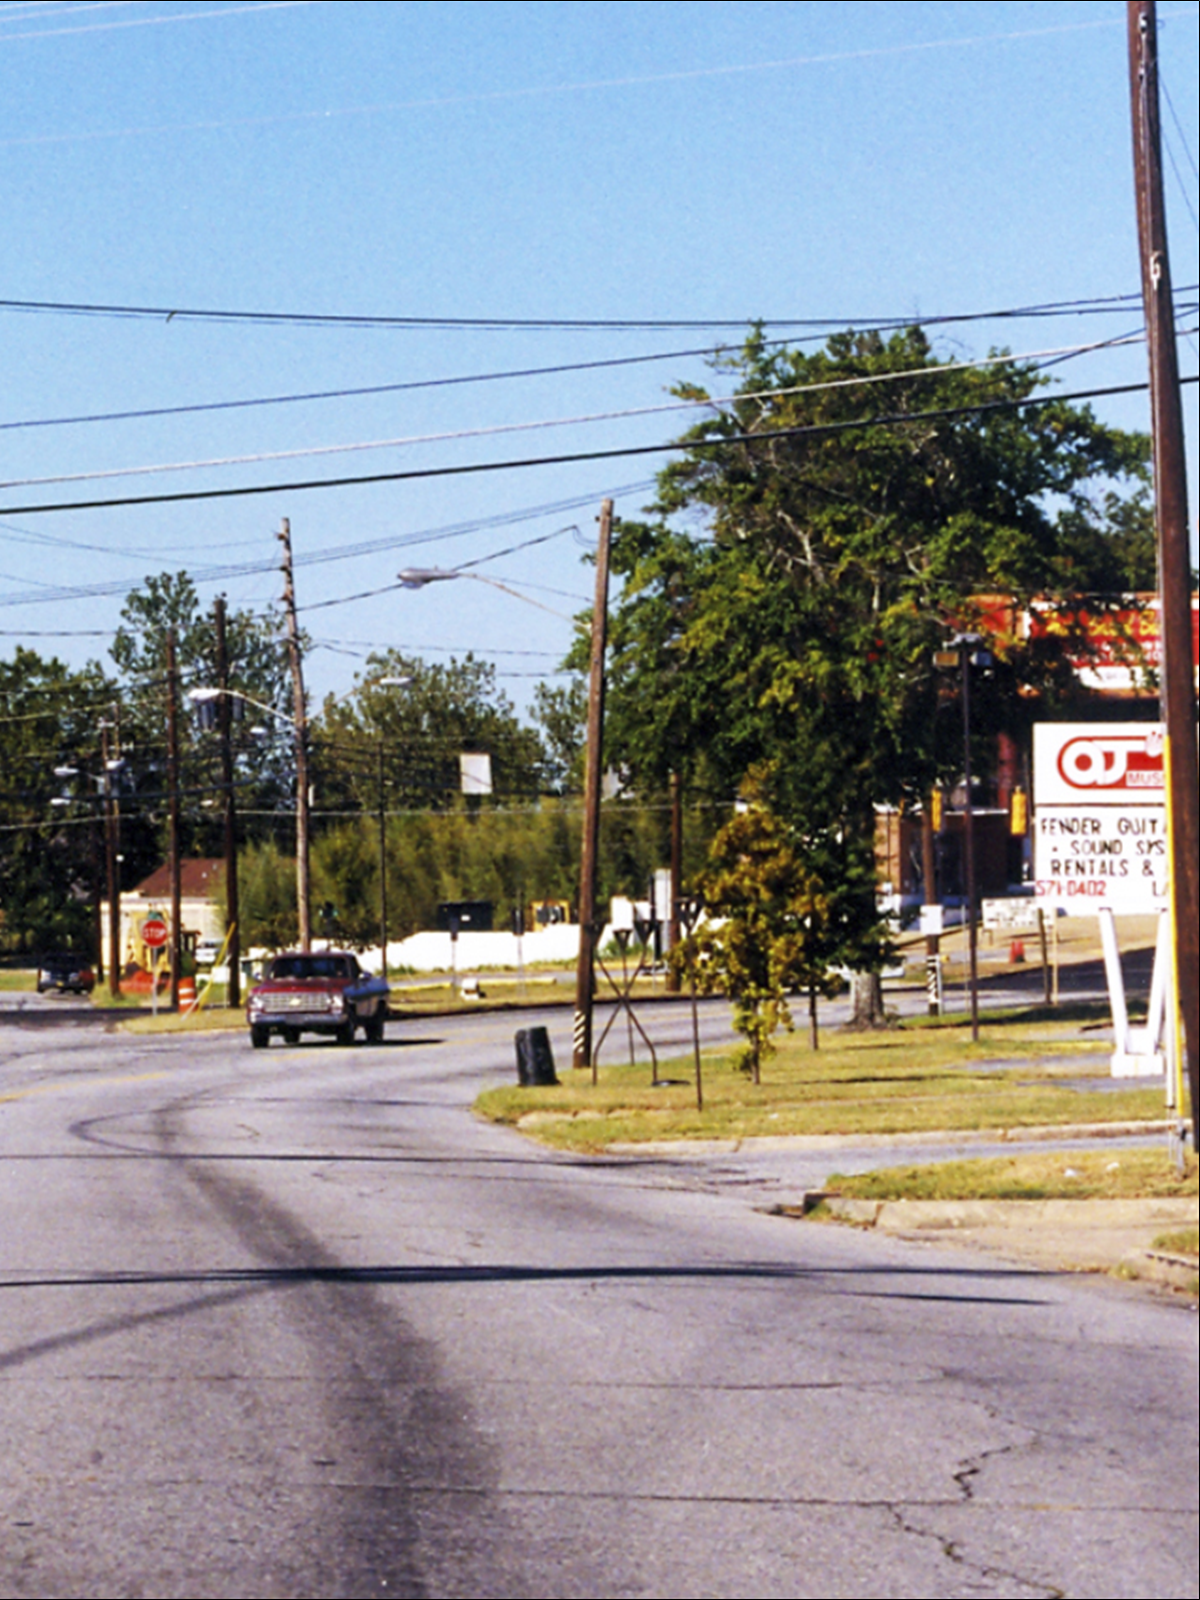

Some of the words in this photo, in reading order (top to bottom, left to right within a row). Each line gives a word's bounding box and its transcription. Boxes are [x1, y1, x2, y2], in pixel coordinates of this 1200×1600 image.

[1041, 817, 1101, 835] FENDER
[1117, 817, 1167, 835] GUIT
[1070, 839, 1122, 855] SOUND
[1050, 859, 1128, 877] RENTALS
[143, 927, 166, 939] STOP
